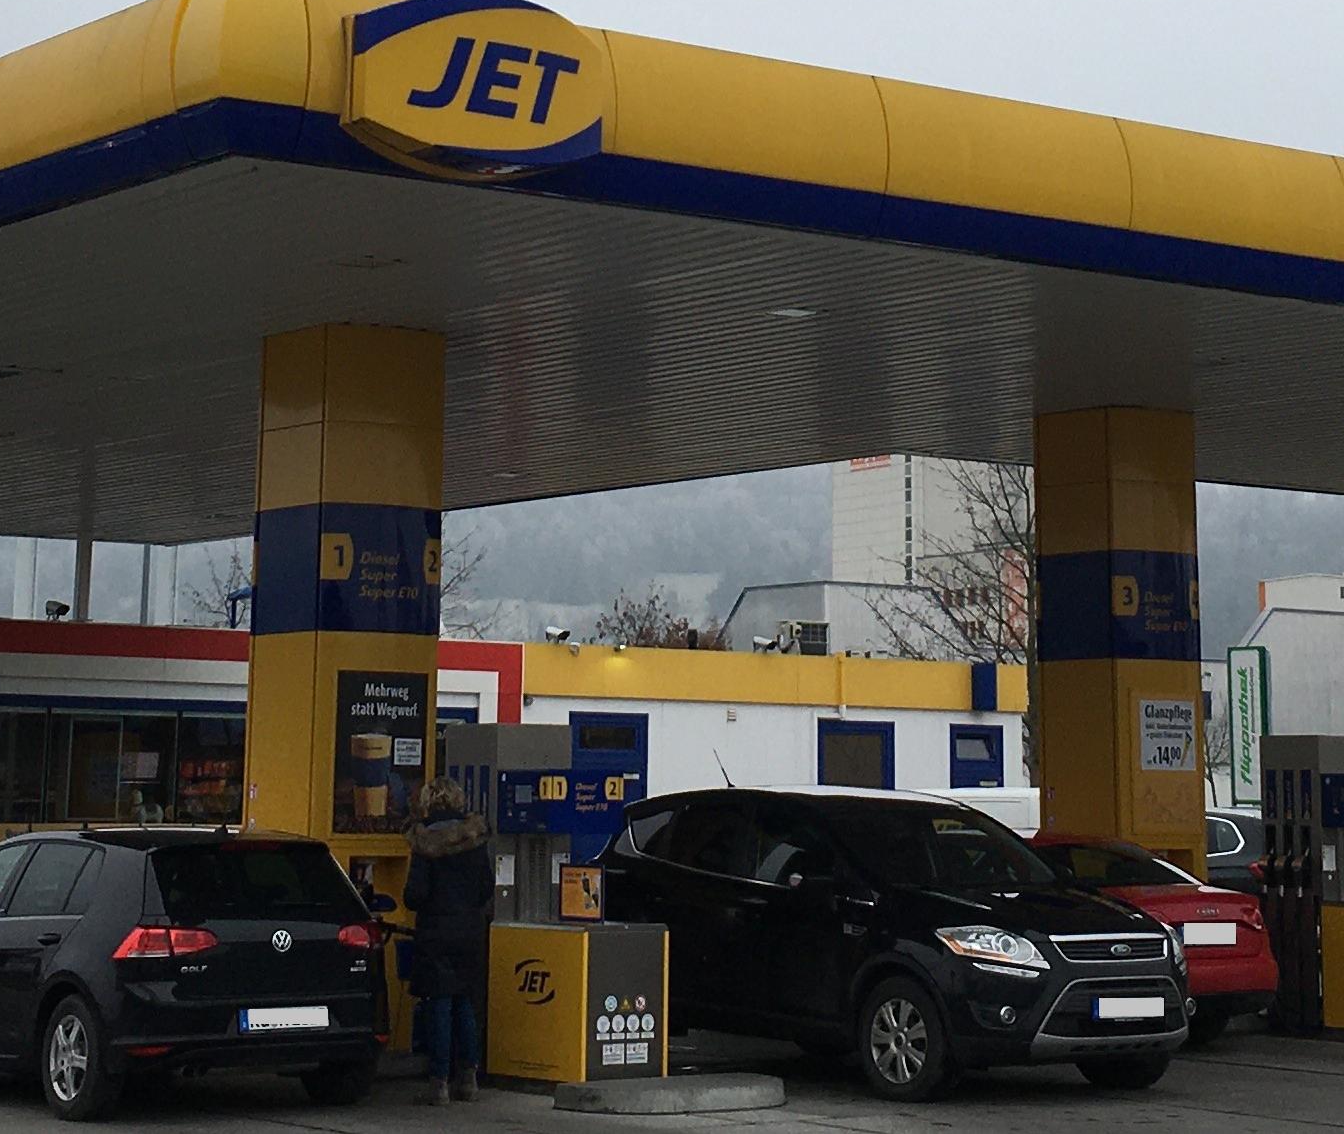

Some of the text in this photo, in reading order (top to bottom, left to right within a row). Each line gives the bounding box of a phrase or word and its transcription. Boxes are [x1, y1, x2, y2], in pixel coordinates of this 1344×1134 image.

[407, 36, 580, 124] JET
[334, 546, 344, 567] 1
[428, 550, 437, 572] 2
[1122, 586, 1133, 606] 3
[364, 682, 409, 701] Mehrweg
[351, 702, 375, 716] statt
[609, 782, 617, 795] 2
[518, 971, 551, 993] JET
